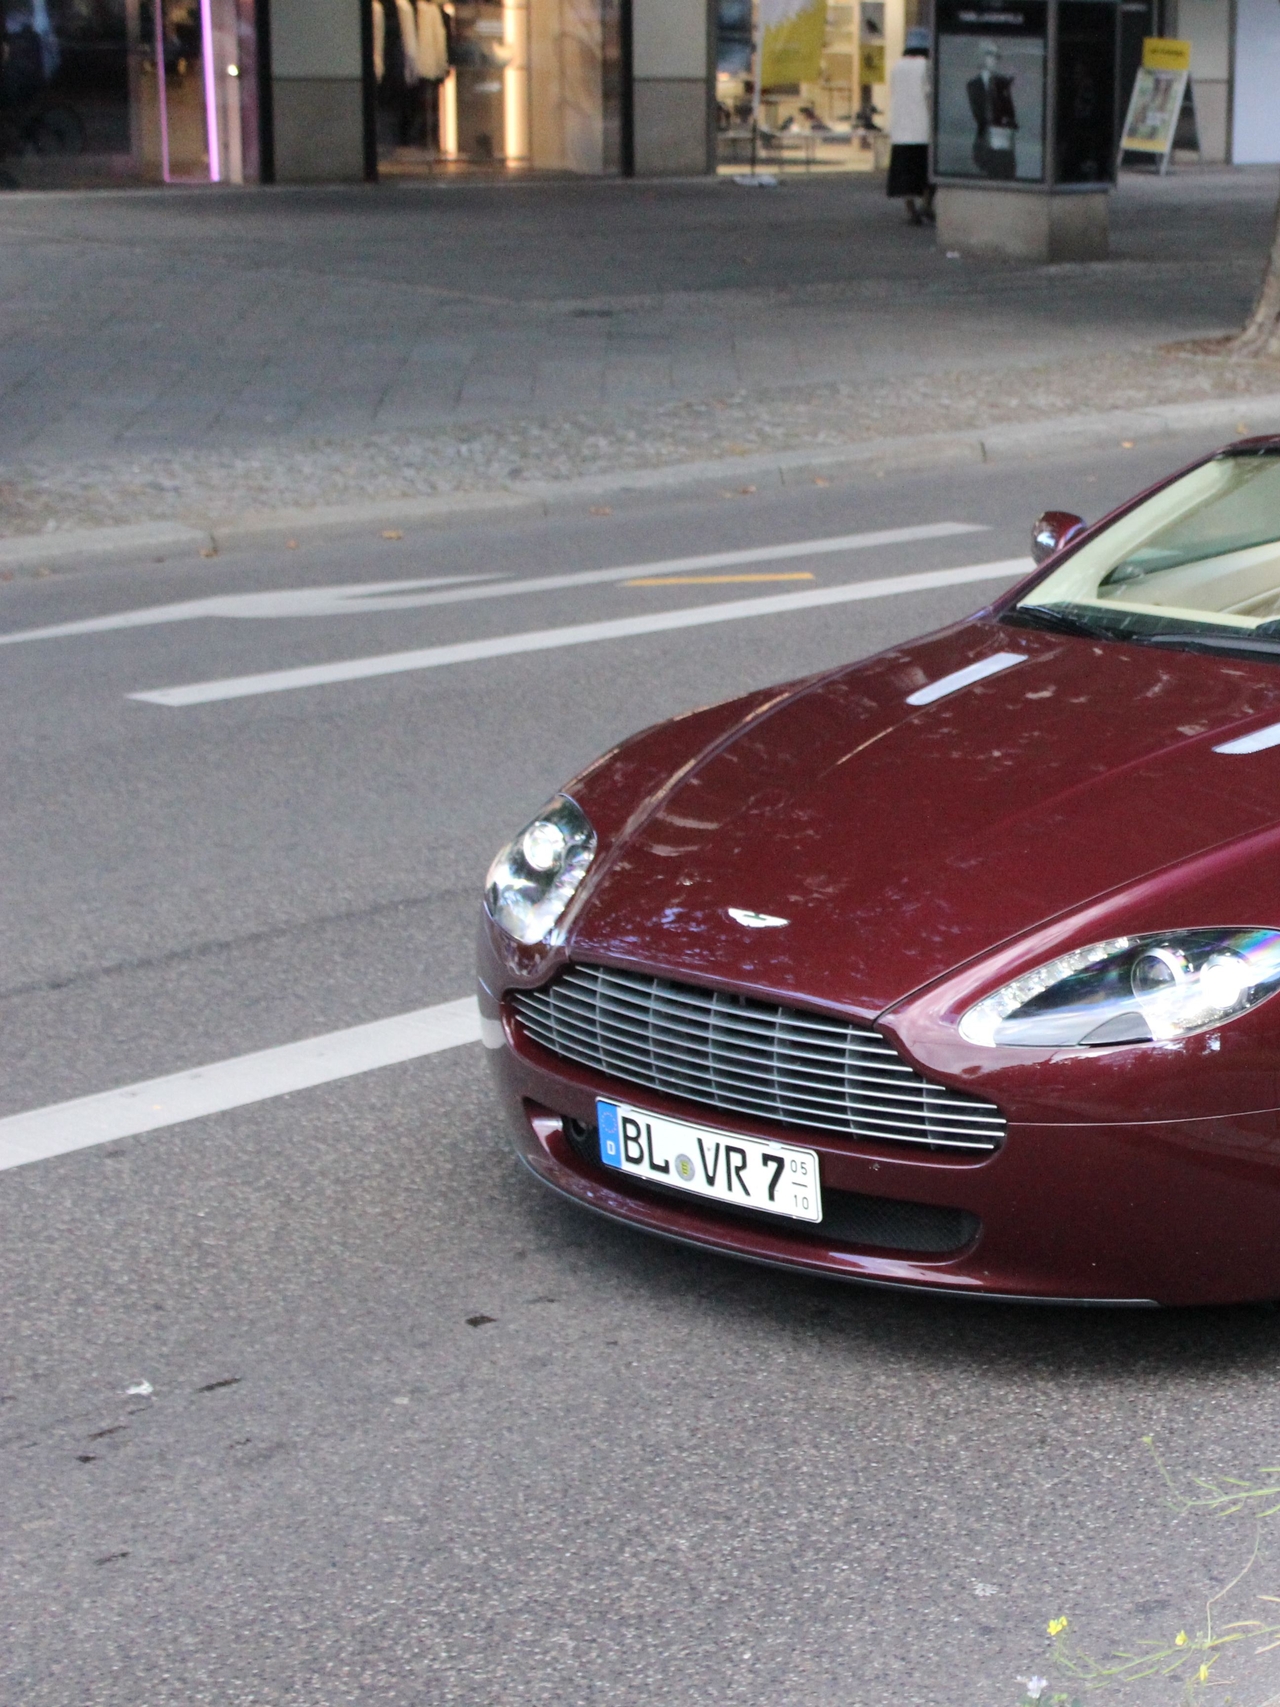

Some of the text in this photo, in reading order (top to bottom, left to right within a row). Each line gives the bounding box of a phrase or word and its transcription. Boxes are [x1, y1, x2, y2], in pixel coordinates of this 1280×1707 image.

[606, 1139, 617, 1156] D
[621, 1115, 785, 1202] BL VR 7
[790, 1159, 808, 1176] 05
[793, 1193, 810, 1210] 10
